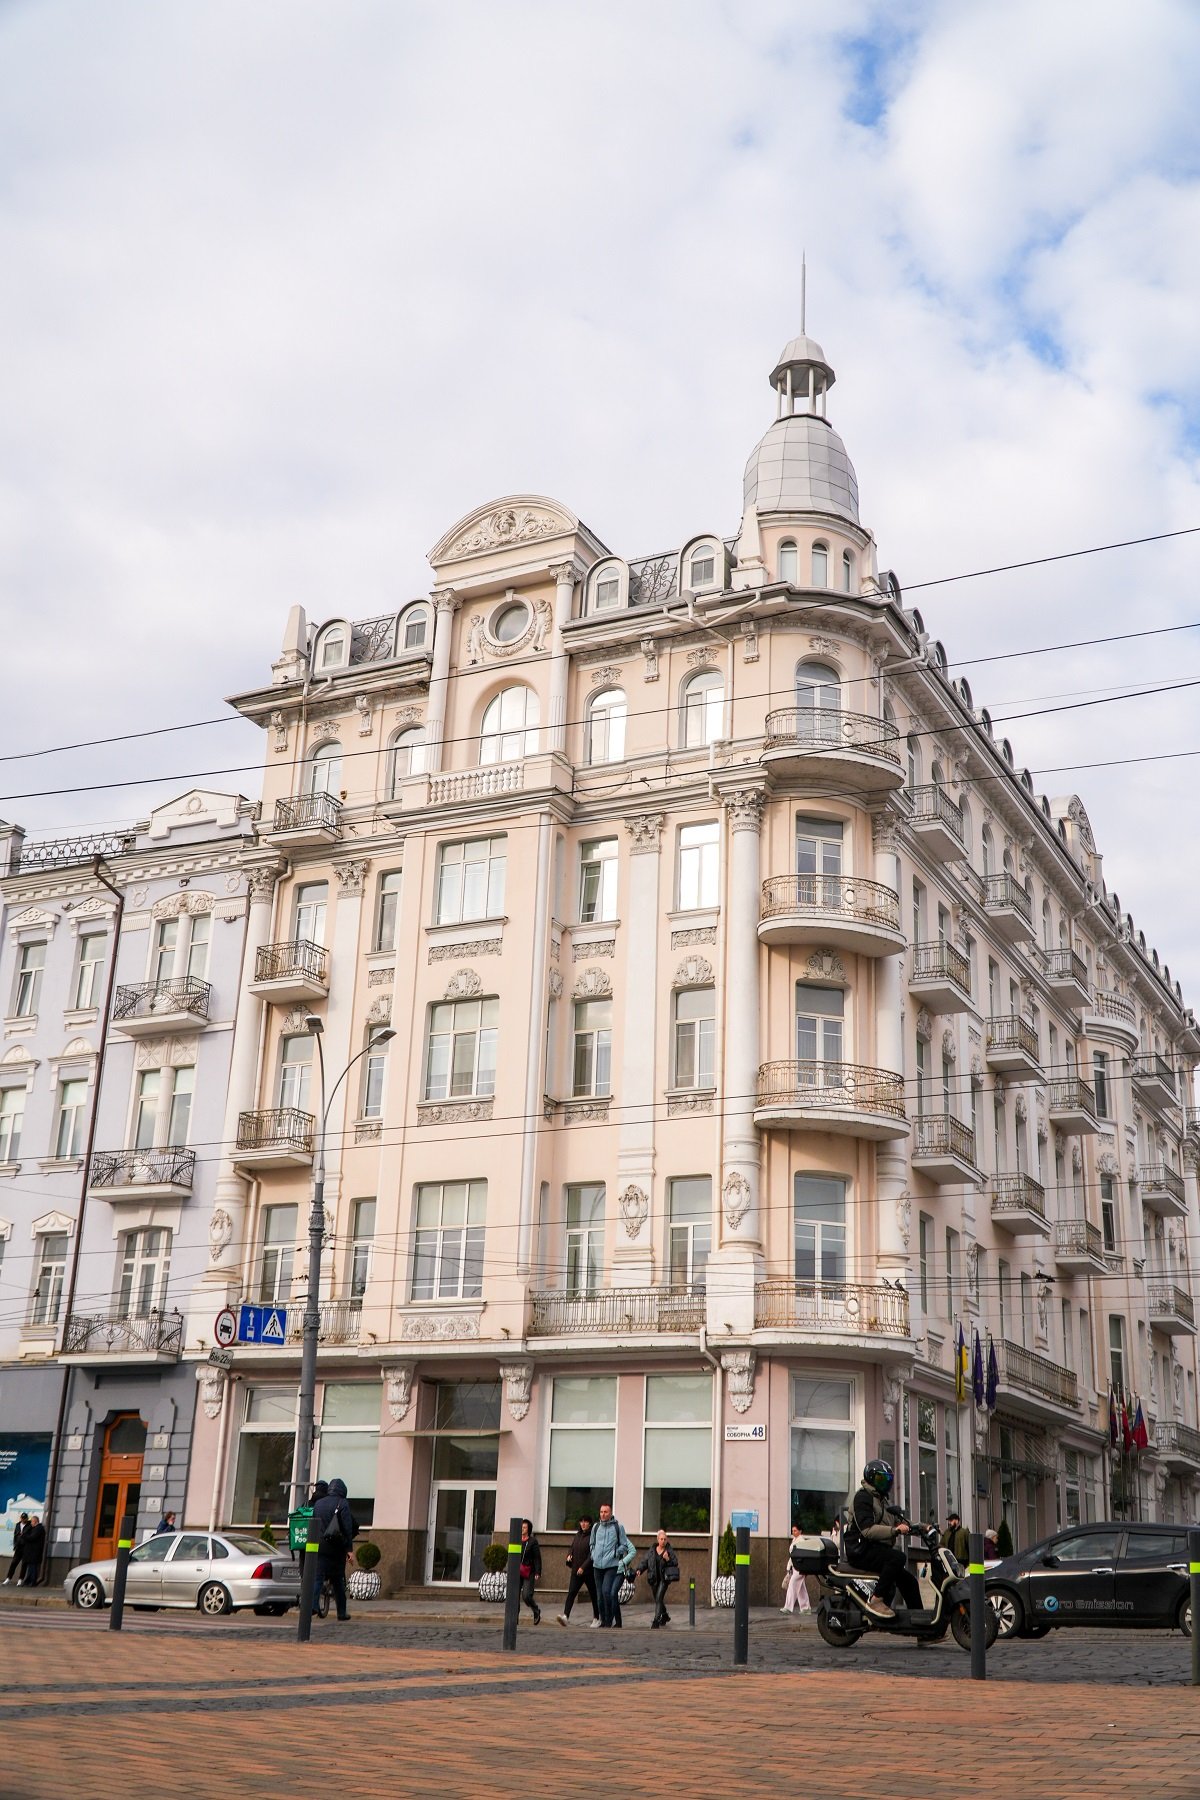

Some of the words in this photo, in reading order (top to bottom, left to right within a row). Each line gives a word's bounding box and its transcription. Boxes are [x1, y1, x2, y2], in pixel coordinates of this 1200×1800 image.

[752, 1426, 764, 1438] 48
[294, 1527, 308, 1535] Bolt
[294, 1535, 307, 1543] Foo
